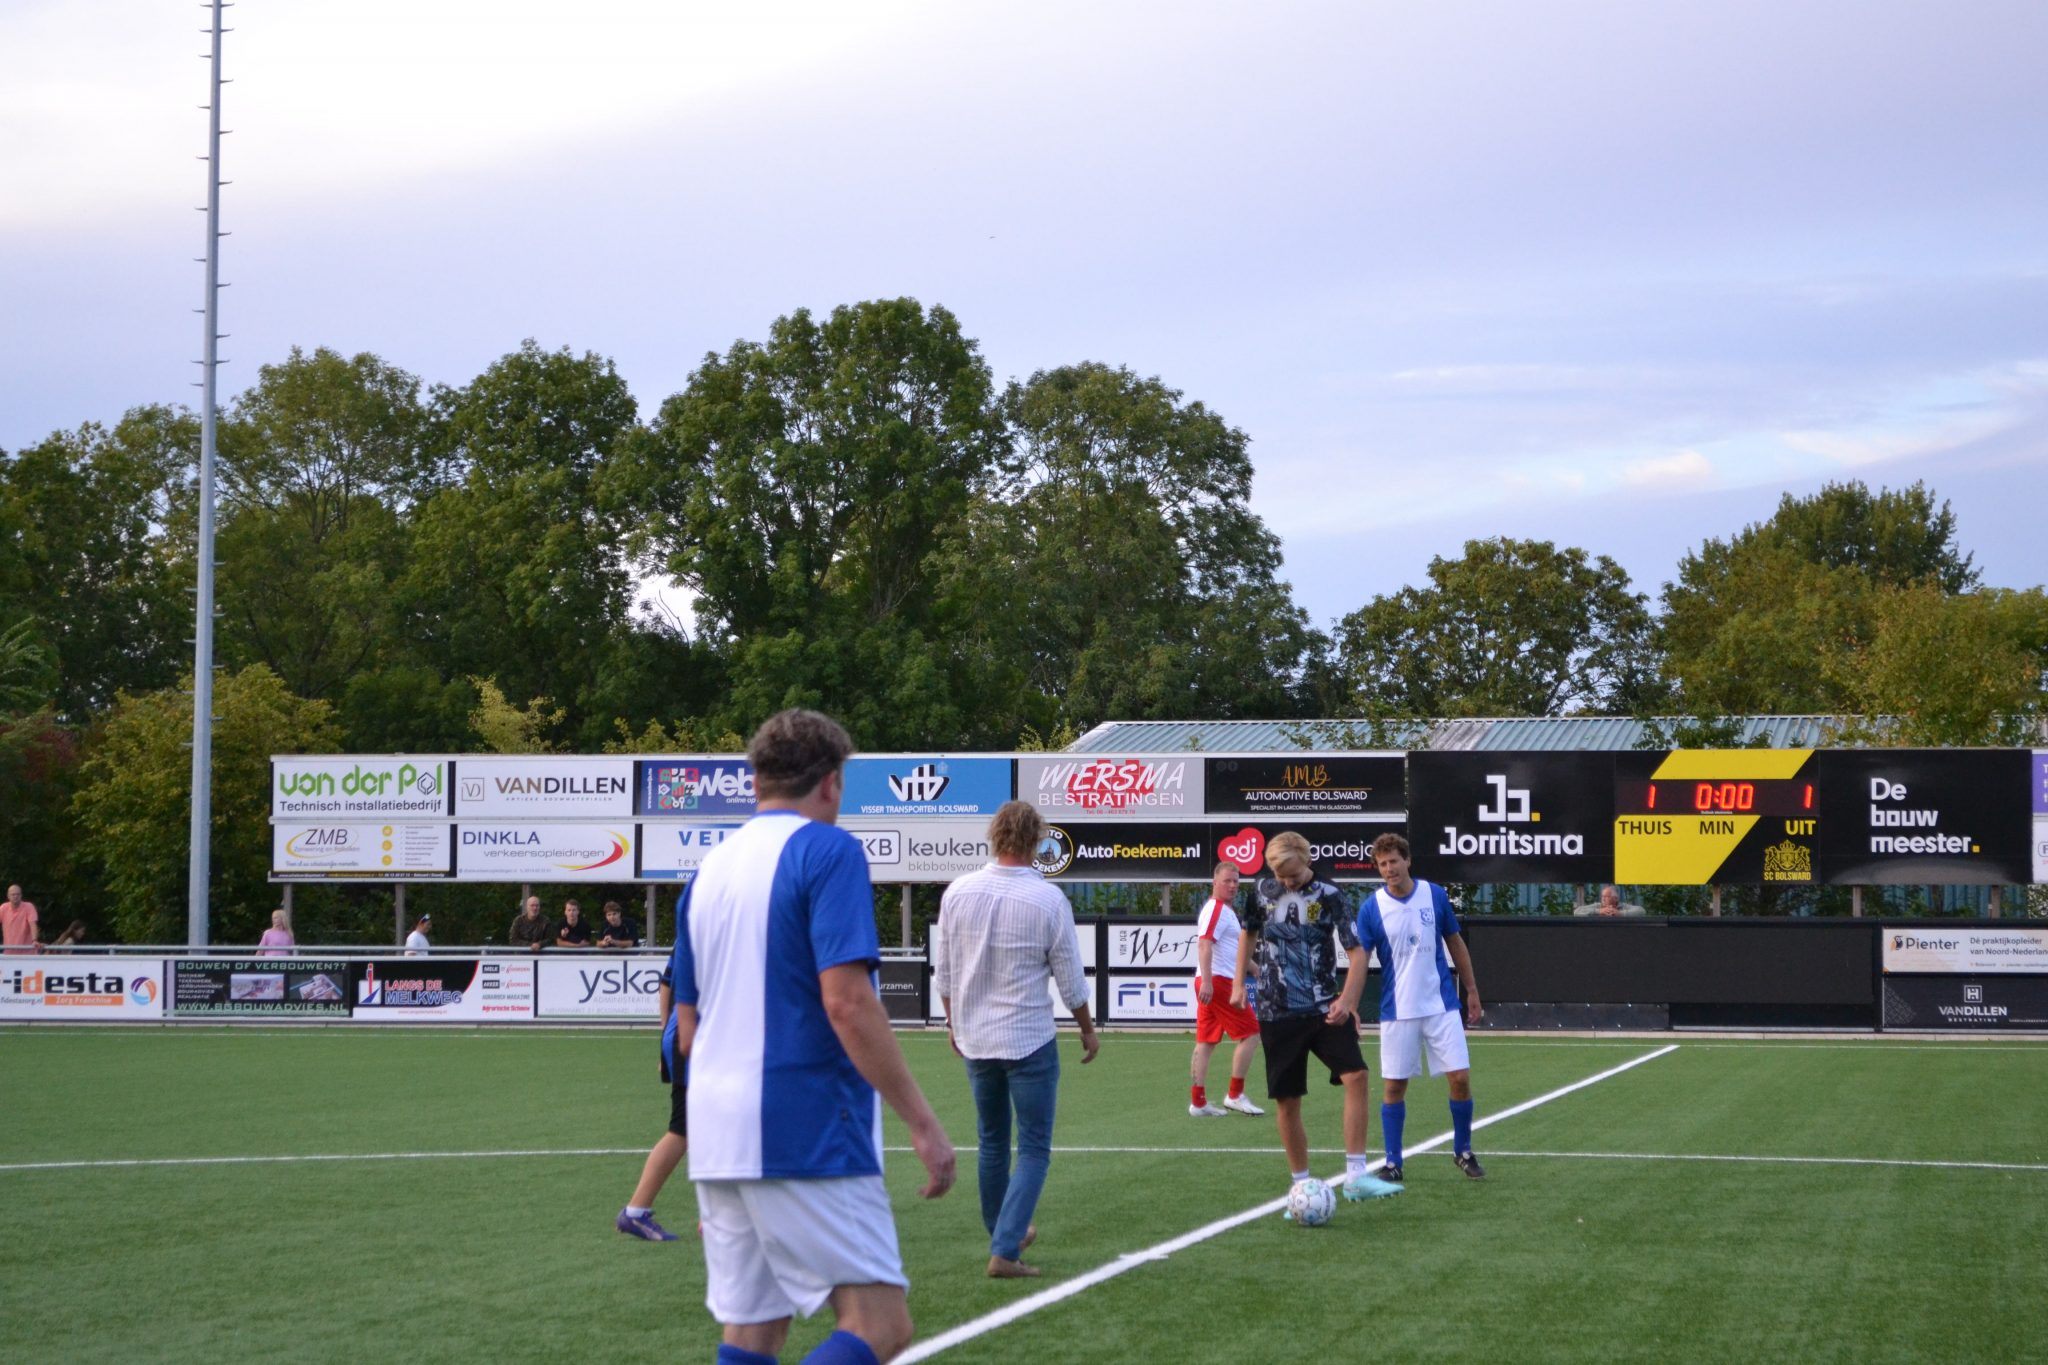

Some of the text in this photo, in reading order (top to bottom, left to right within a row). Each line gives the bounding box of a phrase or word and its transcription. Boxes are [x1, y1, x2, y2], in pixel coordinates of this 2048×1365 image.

[342, 764, 392, 796] der
[1038, 761, 1185, 791] WIERSMA
[495, 777, 626, 794] VANDILLEN
[1871, 778, 1907, 800] De
[1039, 792, 1184, 806] BESTRATINGEN
[1245, 791, 1367, 801] AUTOMOTIVE BOLSWARD
[1648, 784, 1812, 810] 1 0:00 1
[280, 800, 442, 812] Technisch installatiebedrijf
[861, 804, 978, 814] VISSER TRANSPORTEN BOLSWARD
[1871, 804, 1938, 827] bouw
[1619, 820, 1816, 835] THUIS MIN UIT
[305, 829, 348, 845] ZMB
[463, 831, 541, 845] DINKLA
[1439, 827, 1583, 855] Jorritsma
[1871, 833, 1980, 853] meester.
[484, 849, 604, 858] verkeersopleidingen
[860, 838, 893, 857] KB
[908, 838, 989, 857] keuken
[1077, 843, 1201, 858] AutoFoekema.nl
[1226, 838, 1256, 863] odj
[1032, 853, 1070, 873] OEKEMA
[1764, 871, 1811, 880] SC BOLSWARD
[1906, 937, 1960, 950] Pienter
[1982, 937, 2042, 947] praktijkopleider
[177, 962, 347, 970] BOUWEN OF VERBOUWEN??
[0, 970, 123, 993] -idesta
[385, 980, 442, 991] LANGS DE
[385, 991, 462, 1004] MELKWEG
[1938, 1006, 2007, 1016] VANDILLEN
